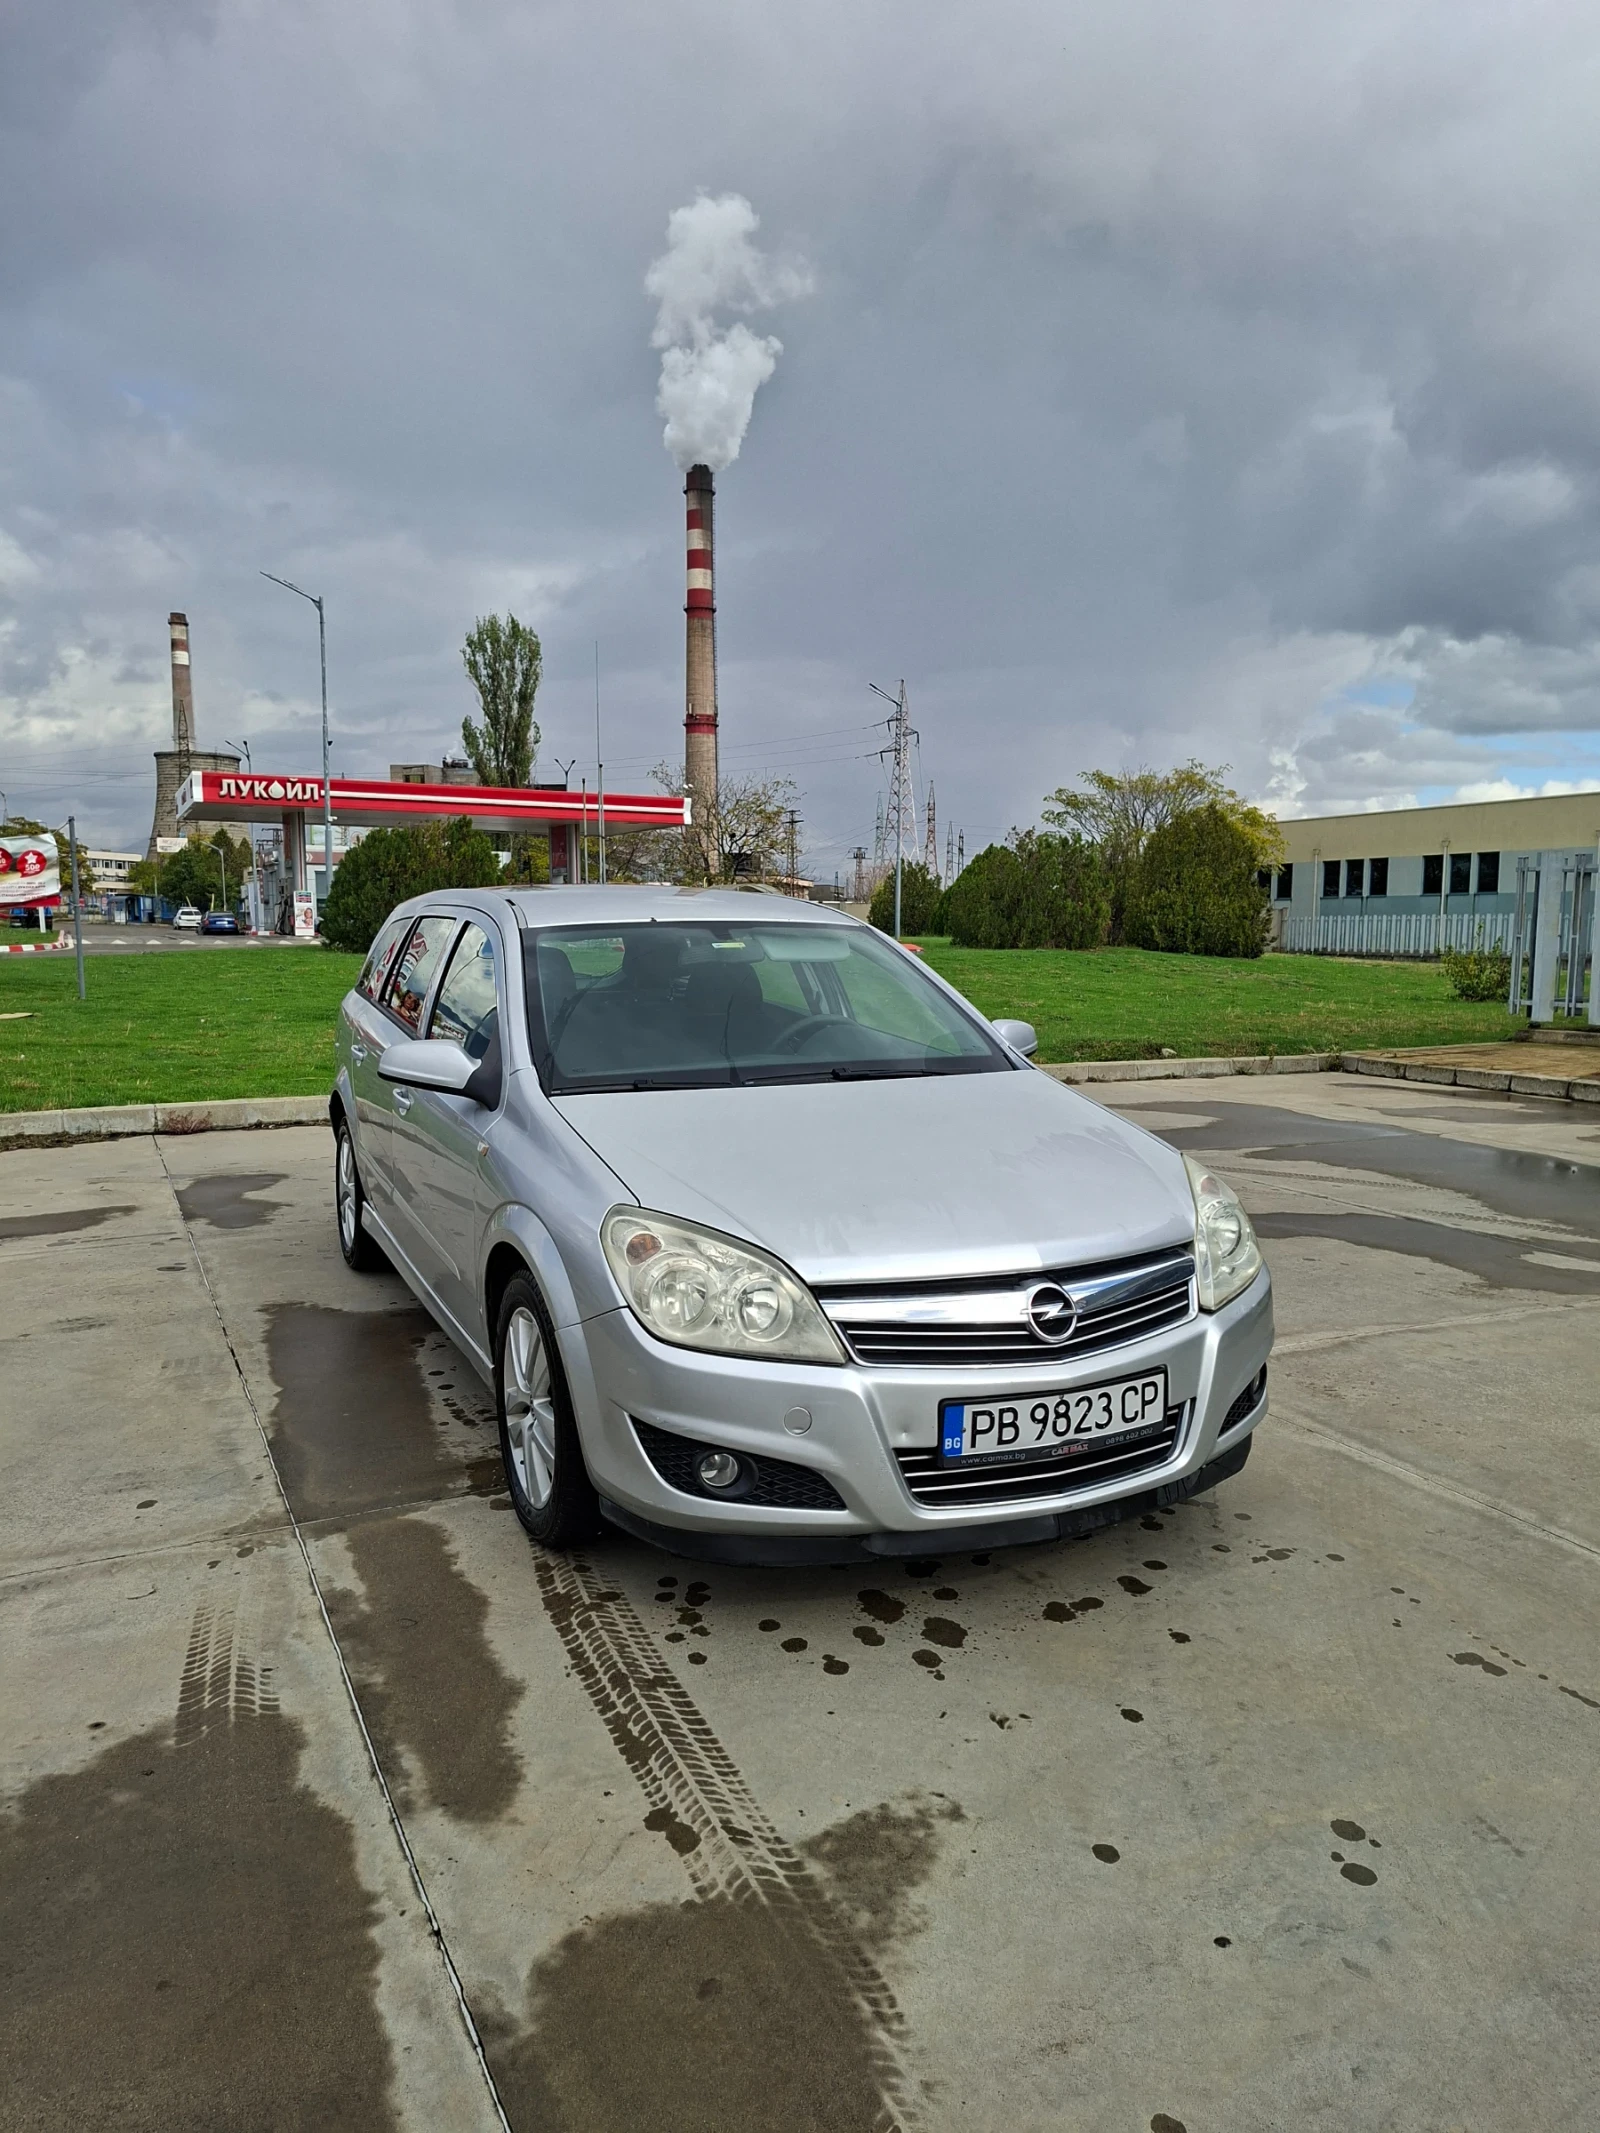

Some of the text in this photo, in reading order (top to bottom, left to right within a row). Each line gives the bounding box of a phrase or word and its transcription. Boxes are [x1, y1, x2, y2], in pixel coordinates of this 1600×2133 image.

[970, 1380, 1159, 1449] PB 9823 CP
[1105, 1427, 1154, 1445] 0898 602 002
[944, 1438, 961, 1450] BG
[960, 1451, 1025, 1464] www.carmax.bg
